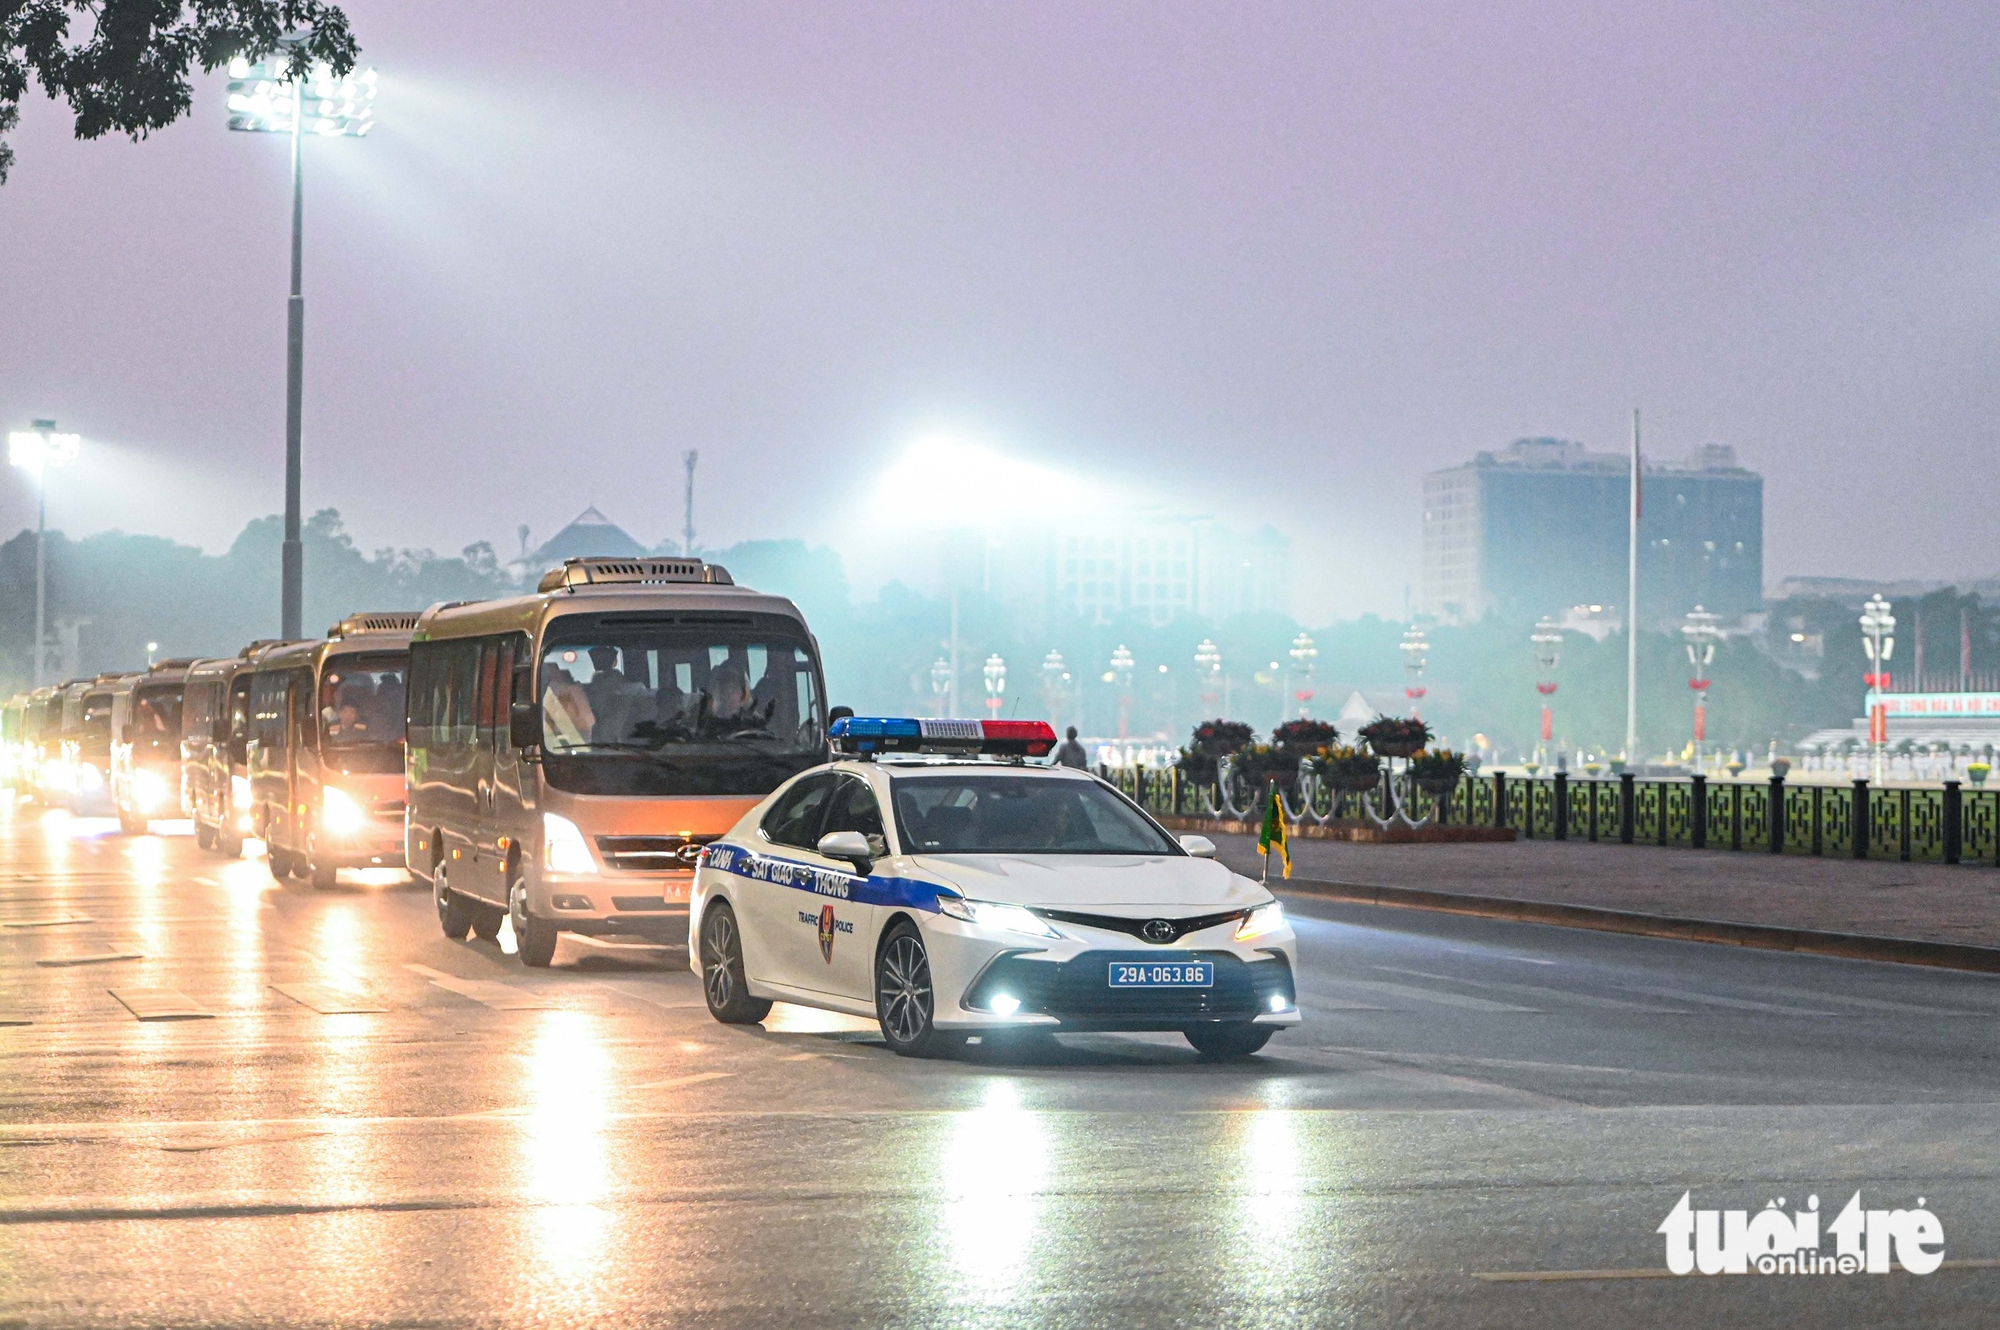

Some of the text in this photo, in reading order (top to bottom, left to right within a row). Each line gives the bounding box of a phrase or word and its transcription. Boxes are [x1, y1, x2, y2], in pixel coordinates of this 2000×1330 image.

[771, 863, 793, 885] GIAO
[798, 911, 818, 926] TRAFFIC
[835, 920, 853, 934] POLICE
[1118, 967, 1204, 982] 29A-063.86
